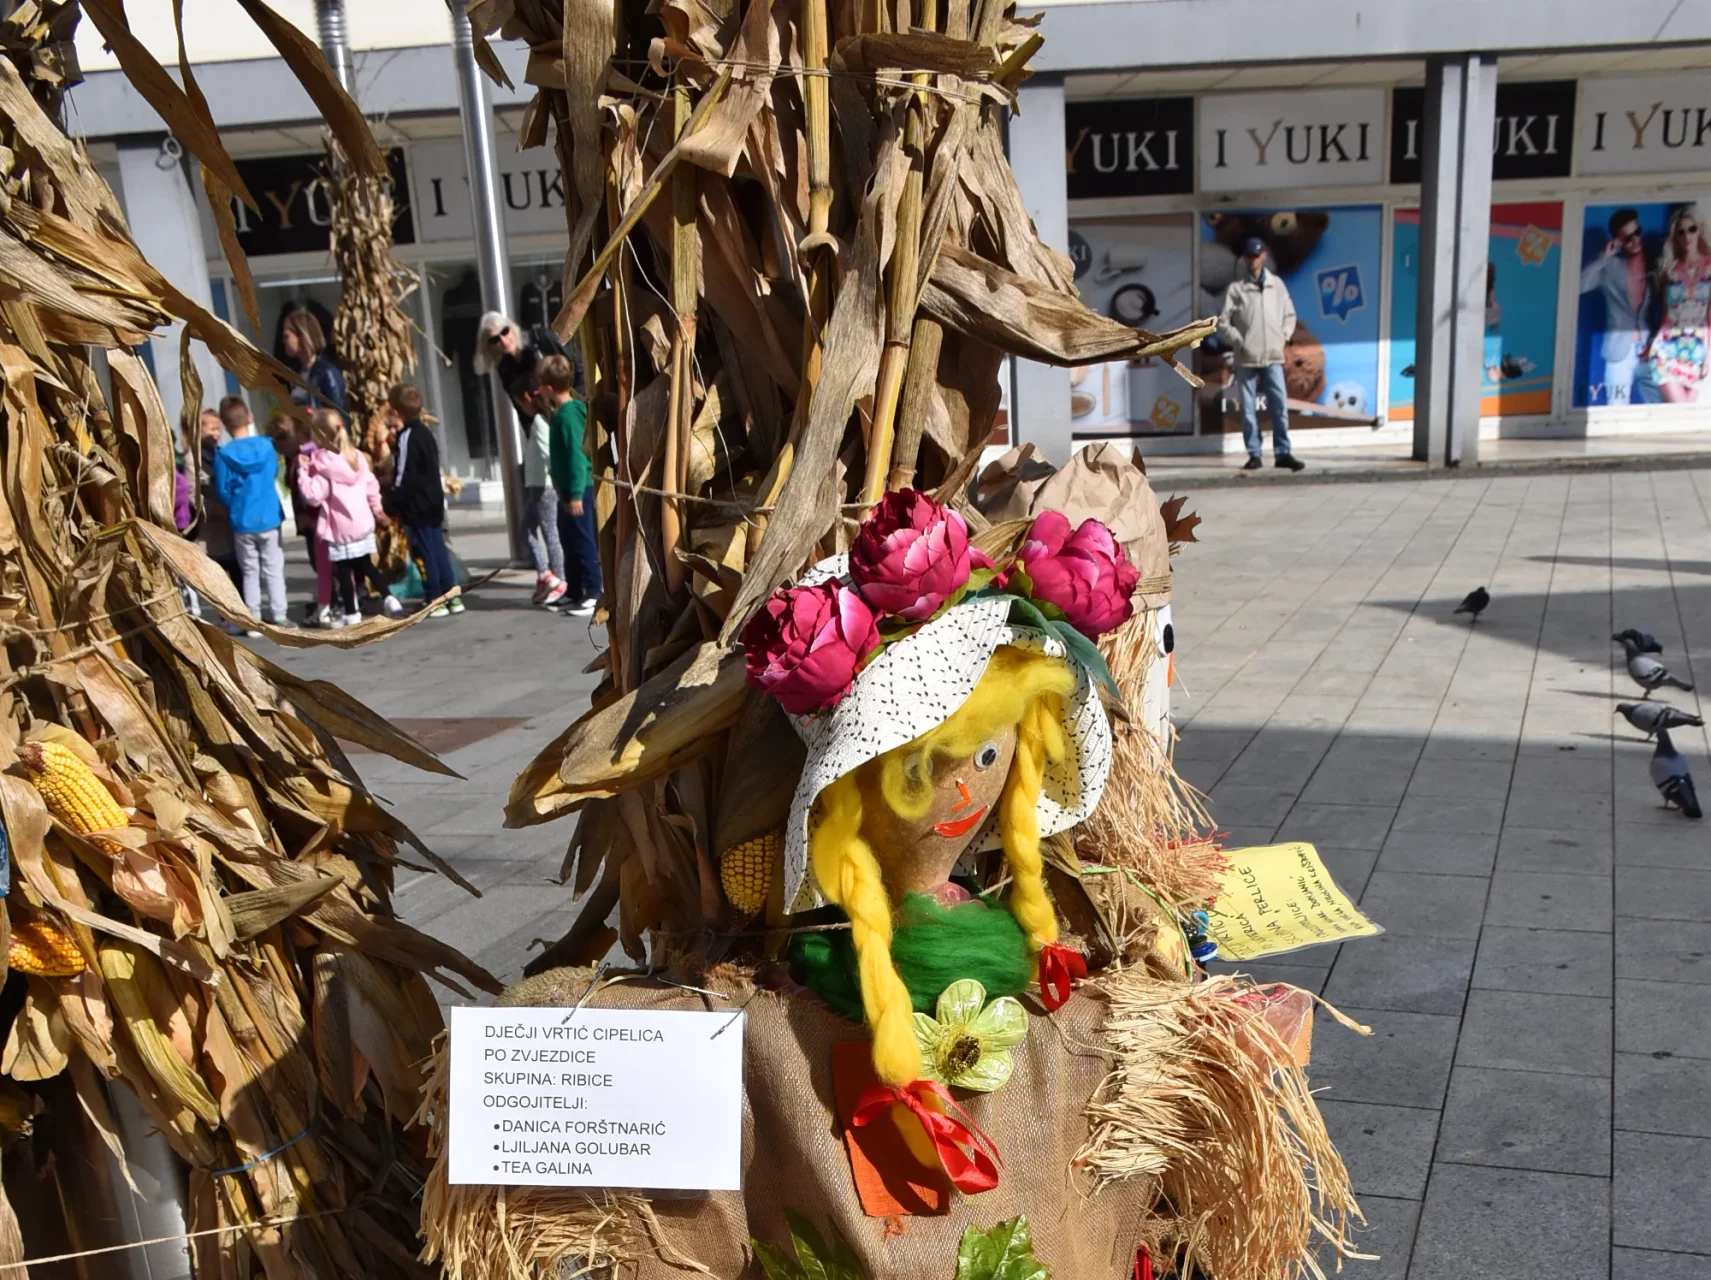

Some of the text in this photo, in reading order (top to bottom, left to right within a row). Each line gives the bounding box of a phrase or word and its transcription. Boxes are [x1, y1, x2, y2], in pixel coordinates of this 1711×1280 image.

[1592, 101, 1711, 151] I YUK
[1215, 117, 1370, 168] I YUKI
[485, 1024, 664, 1042] DJEČJI VRTIĆ CIPELICA
[485, 1049, 596, 1064] PO ZVJEZDICE
[483, 1072, 613, 1087] SKUPINA: RIBICE
[483, 1095, 588, 1110] ODGOJITELJI:
[502, 1119, 666, 1136] DANICA FORŠTNARIĆ
[501, 1140, 651, 1156] LJILJANA GOLUBAR
[501, 1160, 592, 1175] TEA GALINA
